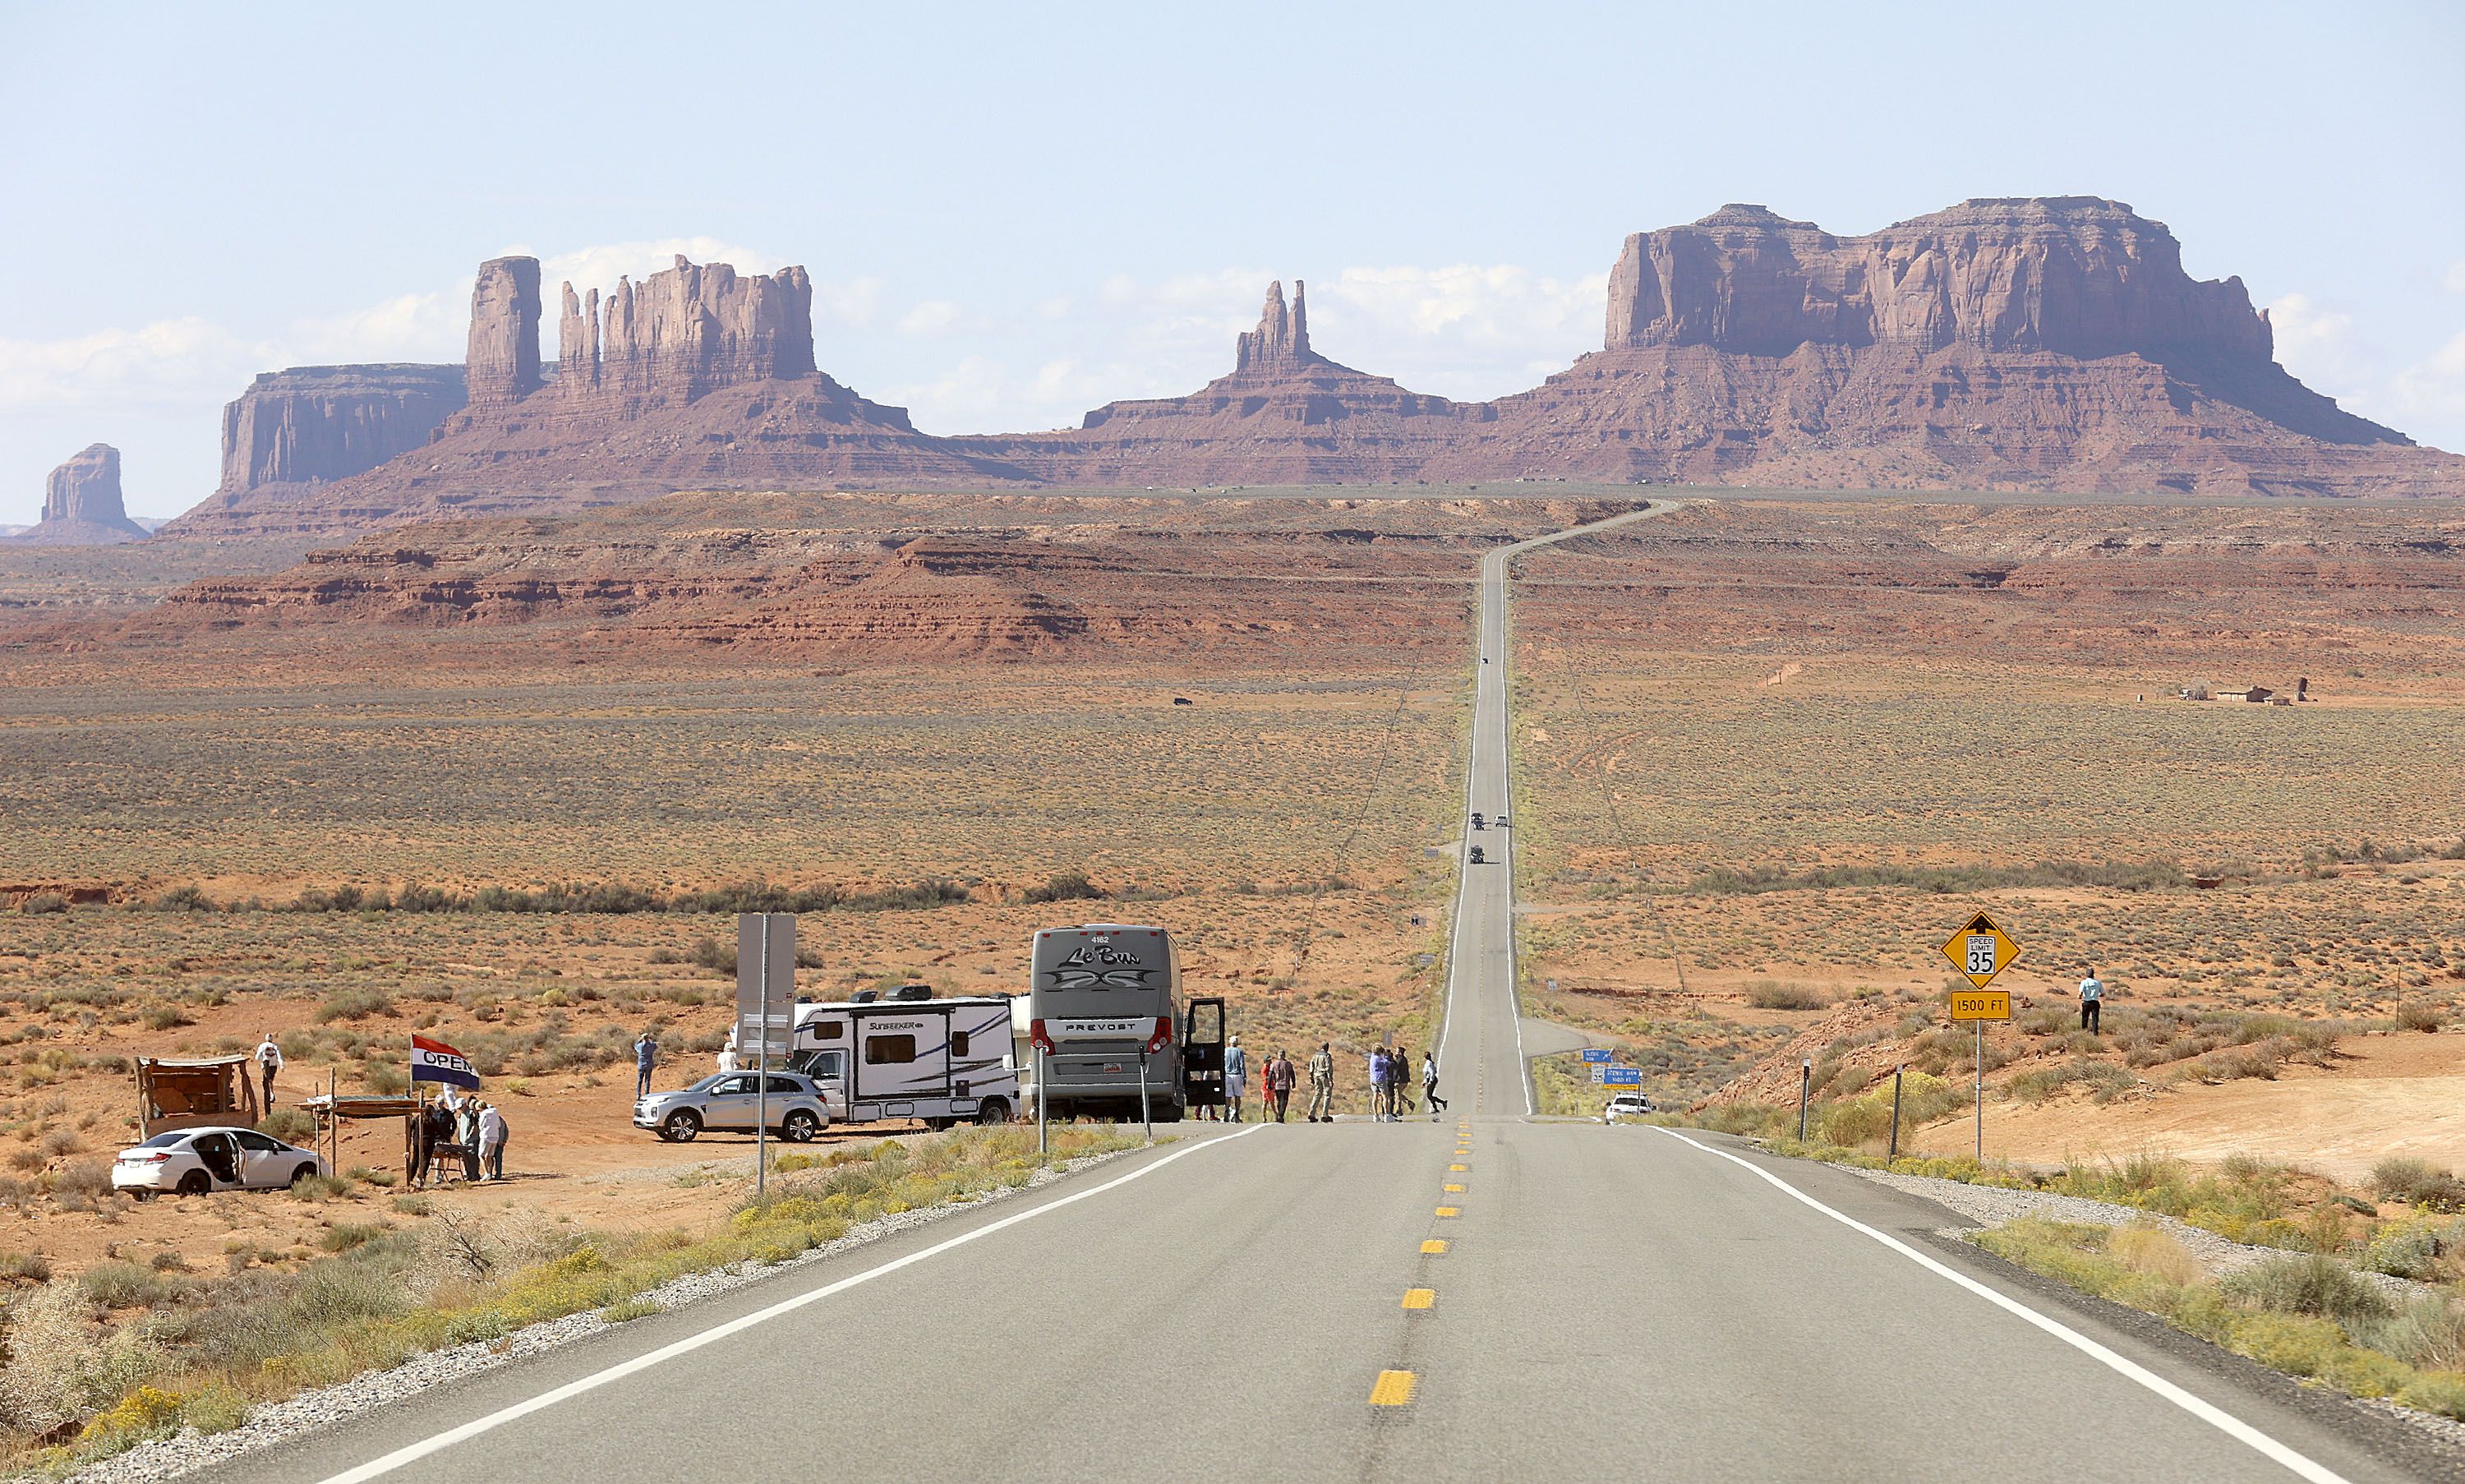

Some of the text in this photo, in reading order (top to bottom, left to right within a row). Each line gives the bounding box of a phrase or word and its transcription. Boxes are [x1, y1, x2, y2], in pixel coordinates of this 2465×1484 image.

[1057, 945, 1140, 968] Le Bus
[1968, 952, 1993, 972] 35
[1957, 1000, 2003, 1011] 1500 FT
[1066, 1023, 1136, 1031] PREVOST
[423, 1052, 473, 1073] OPEN
